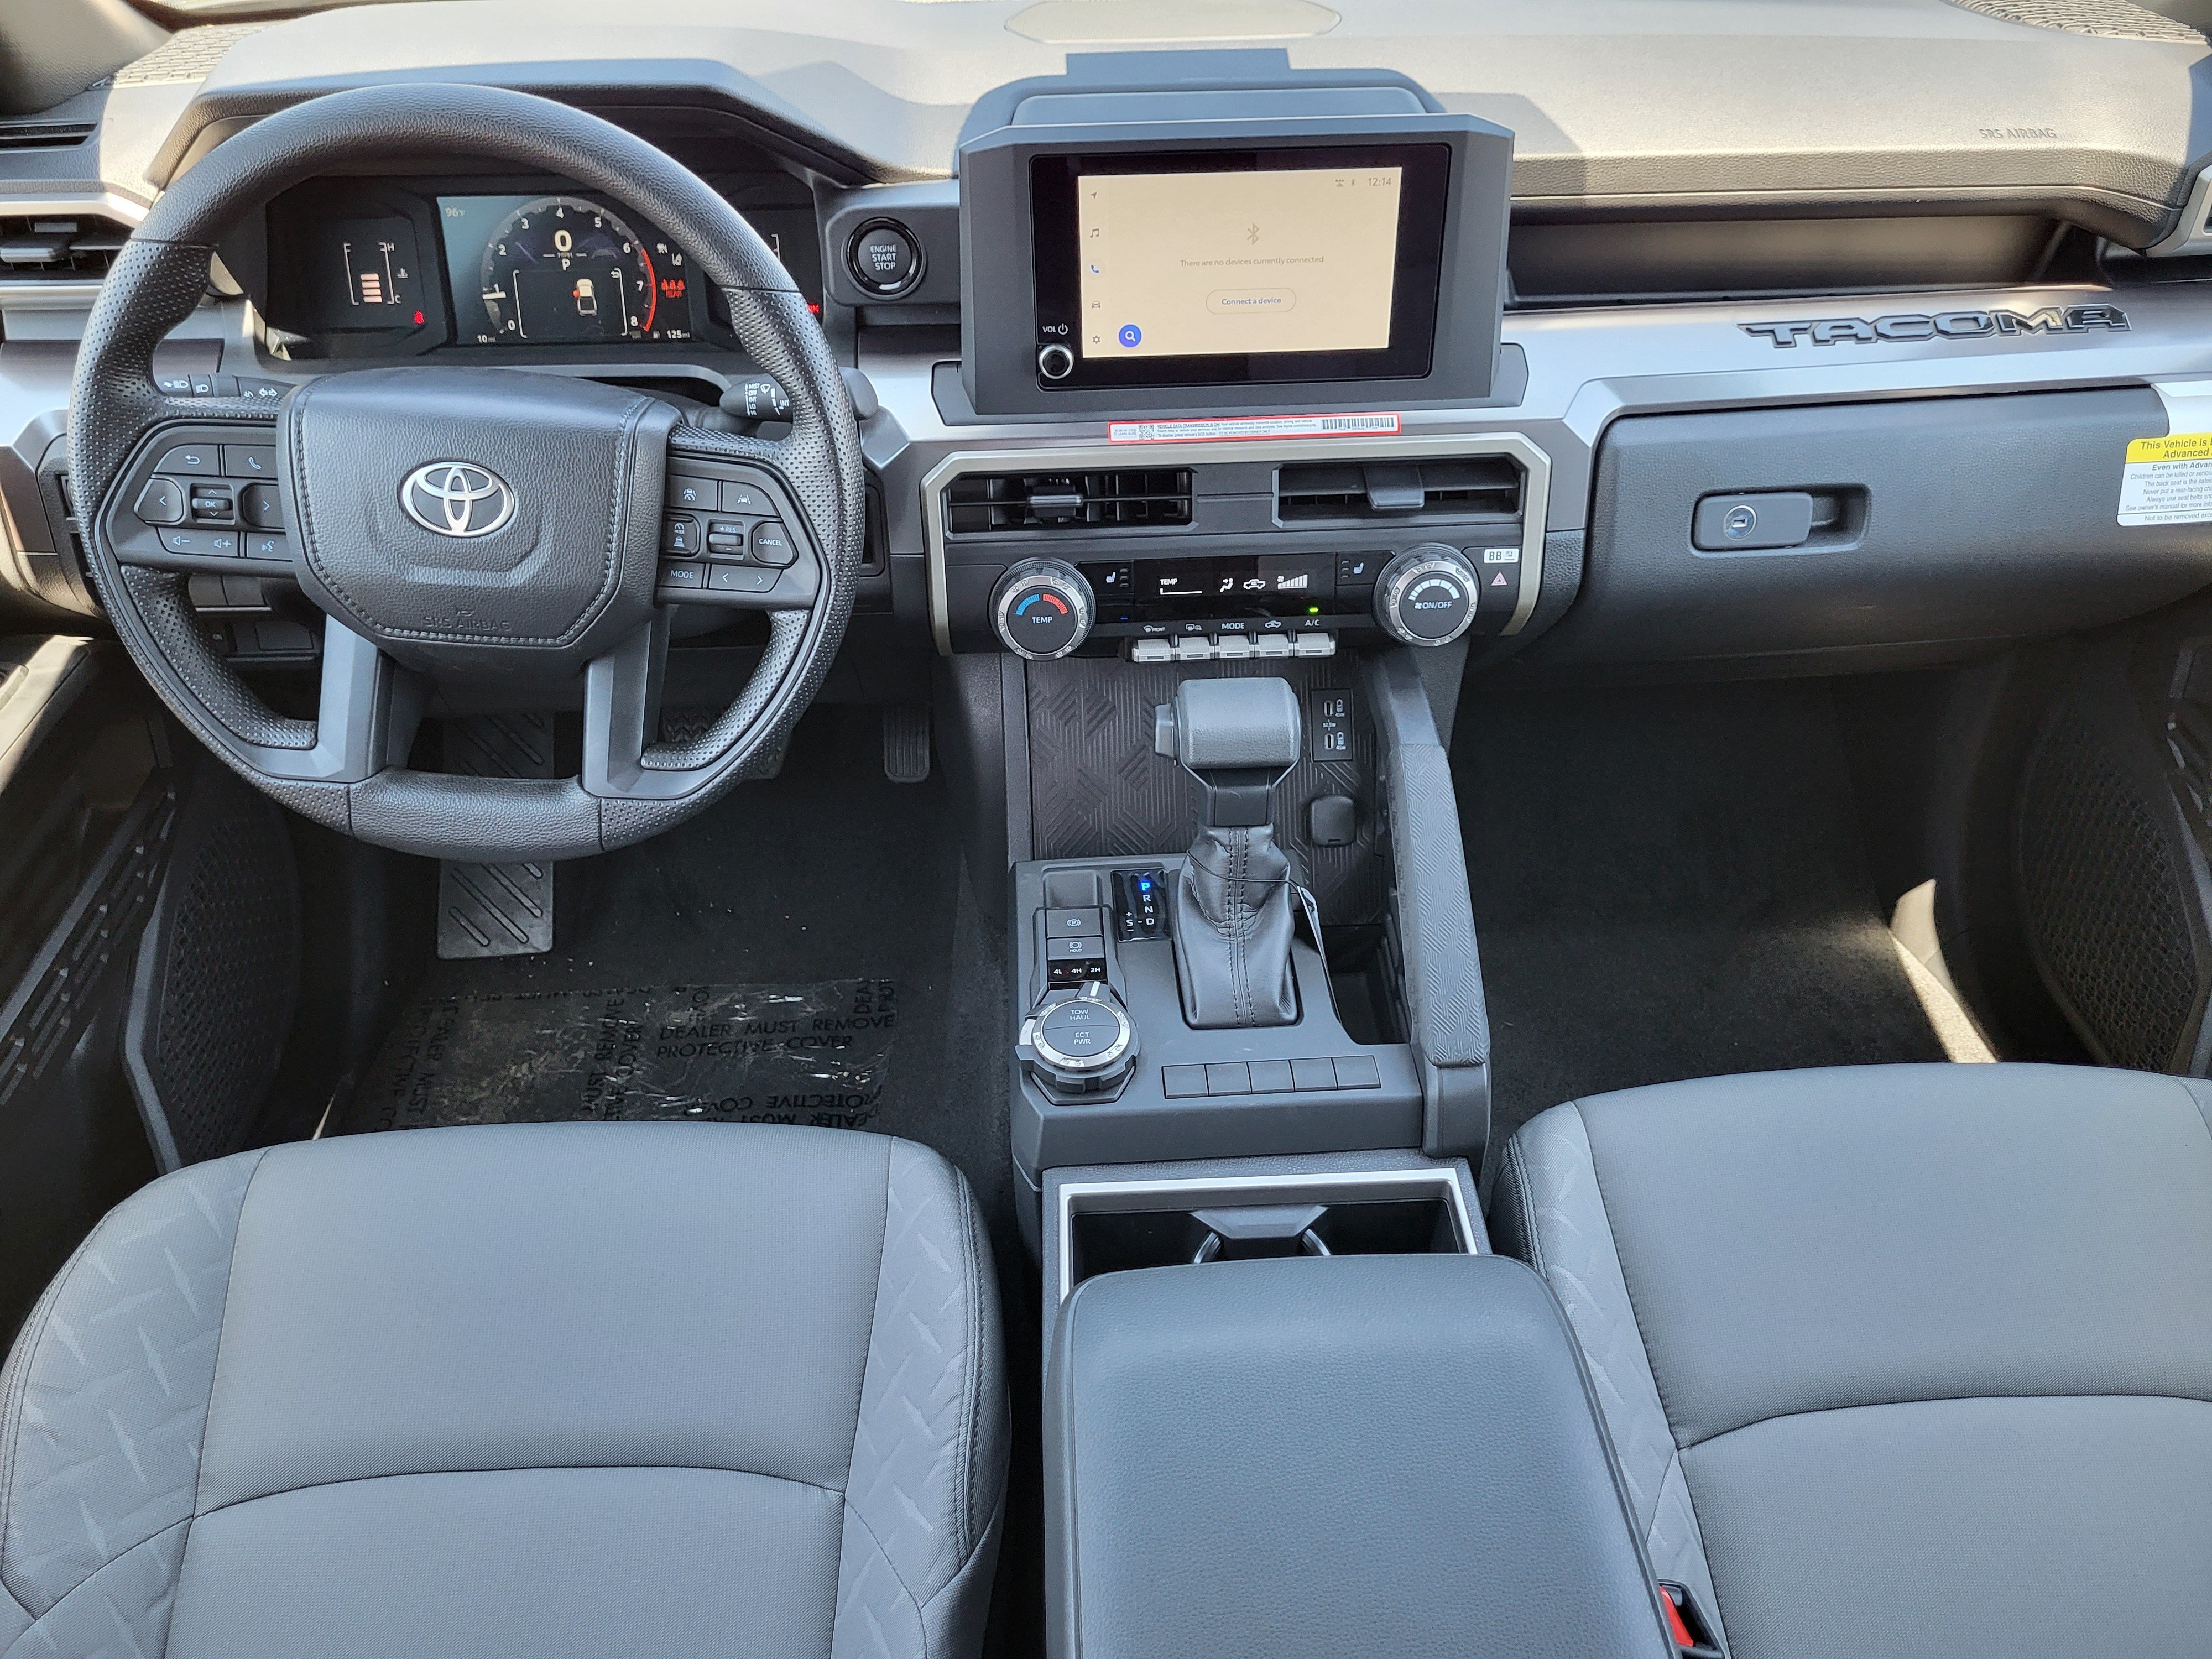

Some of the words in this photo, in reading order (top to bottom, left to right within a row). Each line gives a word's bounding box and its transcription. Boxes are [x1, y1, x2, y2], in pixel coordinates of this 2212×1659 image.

[1979, 129, 2003, 139] SRS
[2006, 128, 2057, 139] AIRBAG
[1369, 177, 1391, 186] 12:14
[556, 207, 564, 218] 4
[521, 218, 529, 229] 3
[594, 217, 602, 228] 5
[555, 229, 572, 252] 0
[387, 242, 395, 252] H
[499, 244, 507, 255] 2
[623, 242, 631, 254] 6
[870, 244, 896, 253] ENGINE
[872, 253, 896, 262] START
[1253, 257, 1285, 265] currently
[562, 258, 570, 270] P
[874, 262, 896, 270] STOP
[636, 280, 644, 291] 7
[394, 294, 401, 304] C
[508, 320, 515, 331] 0
[630, 315, 638, 327] 8
[1734, 303, 2131, 348] TACOMA
[2141, 441, 2161, 450] This
[2164, 439, 2197, 448] Vehicle
[2199, 438, 2207, 446] is
[2163, 448, 2209, 458] Advanced
[759, 538, 782, 546] CANCEL
[670, 569, 694, 579] MODE
[1422, 601, 1453, 609] ON/OFF
[422, 615, 452, 629] SRS
[456, 618, 512, 632] AIRBAG
[1031, 615, 1053, 624] TEMP
[1222, 622, 1245, 630] MODE
[1141, 882, 1150, 891] P
[1142, 894, 1152, 902] R
[1144, 905, 1154, 914] N
[659, 1024, 733, 1041] DEALER
[744, 1019, 800, 1036] MUST
[812, 1013, 895, 1031] REMOVE
[656, 1038, 774, 1059] PROTECTIVE
[785, 1036, 854, 1050] COVER
